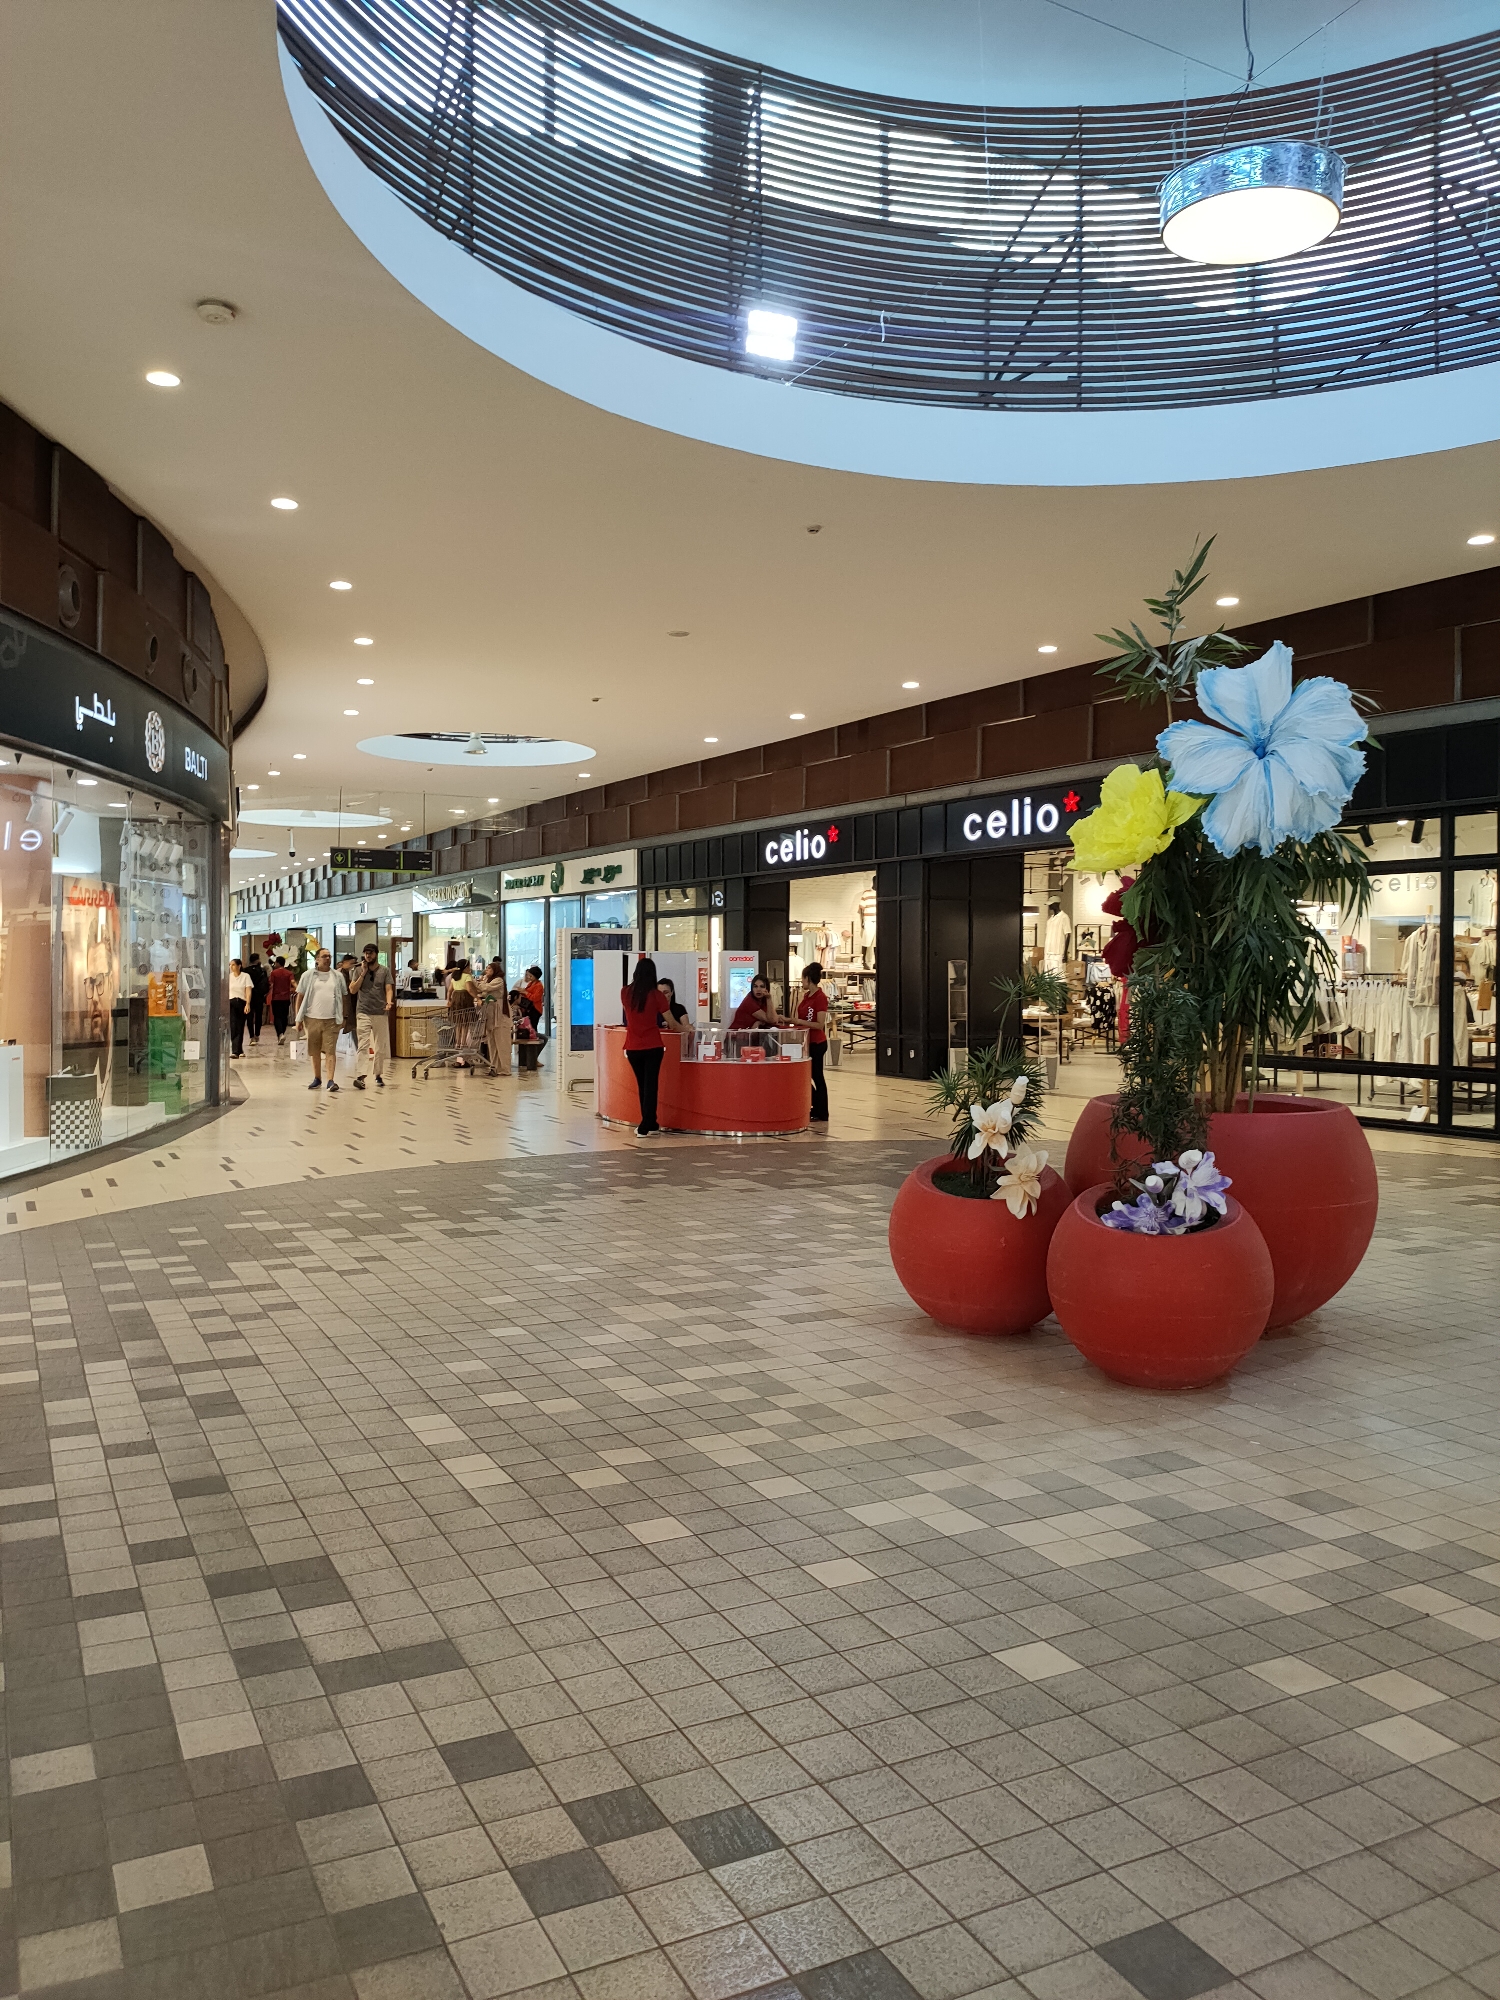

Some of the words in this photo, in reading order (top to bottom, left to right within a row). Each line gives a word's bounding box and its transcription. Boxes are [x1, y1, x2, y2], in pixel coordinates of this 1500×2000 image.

[75, 693, 116, 743] بلطي
[184, 746, 209, 781] BALTI
[962, 796, 1059, 841] celio
[765, 828, 826, 864] celio
[69, 885, 116, 909] CARRERA
[1371, 874, 1438, 893] celio
